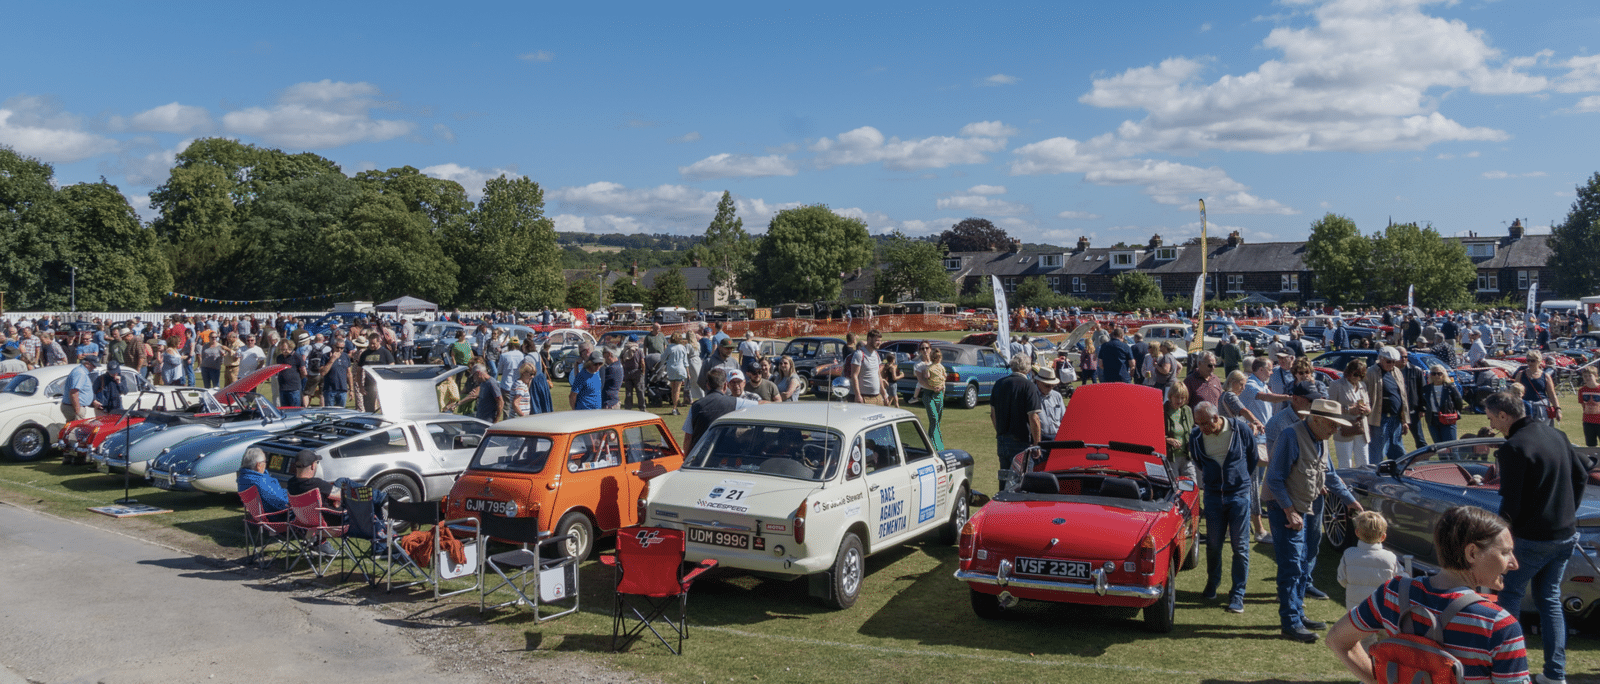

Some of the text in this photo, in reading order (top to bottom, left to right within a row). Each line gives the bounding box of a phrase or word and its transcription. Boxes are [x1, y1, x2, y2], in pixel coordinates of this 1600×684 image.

[725, 489, 744, 500] 21
[822, 502, 830, 511] Sir
[846, 492, 863, 504] Stewart
[880, 486, 895, 504] RACE
[466, 499, 484, 510] GJM
[707, 502, 747, 512] ACESPEED
[880, 501, 904, 521] AGAINST
[879, 516, 906, 538] DEMENTIA
[690, 529, 747, 547] UDM 999G
[1021, 560, 1086, 577] VSF 232R
